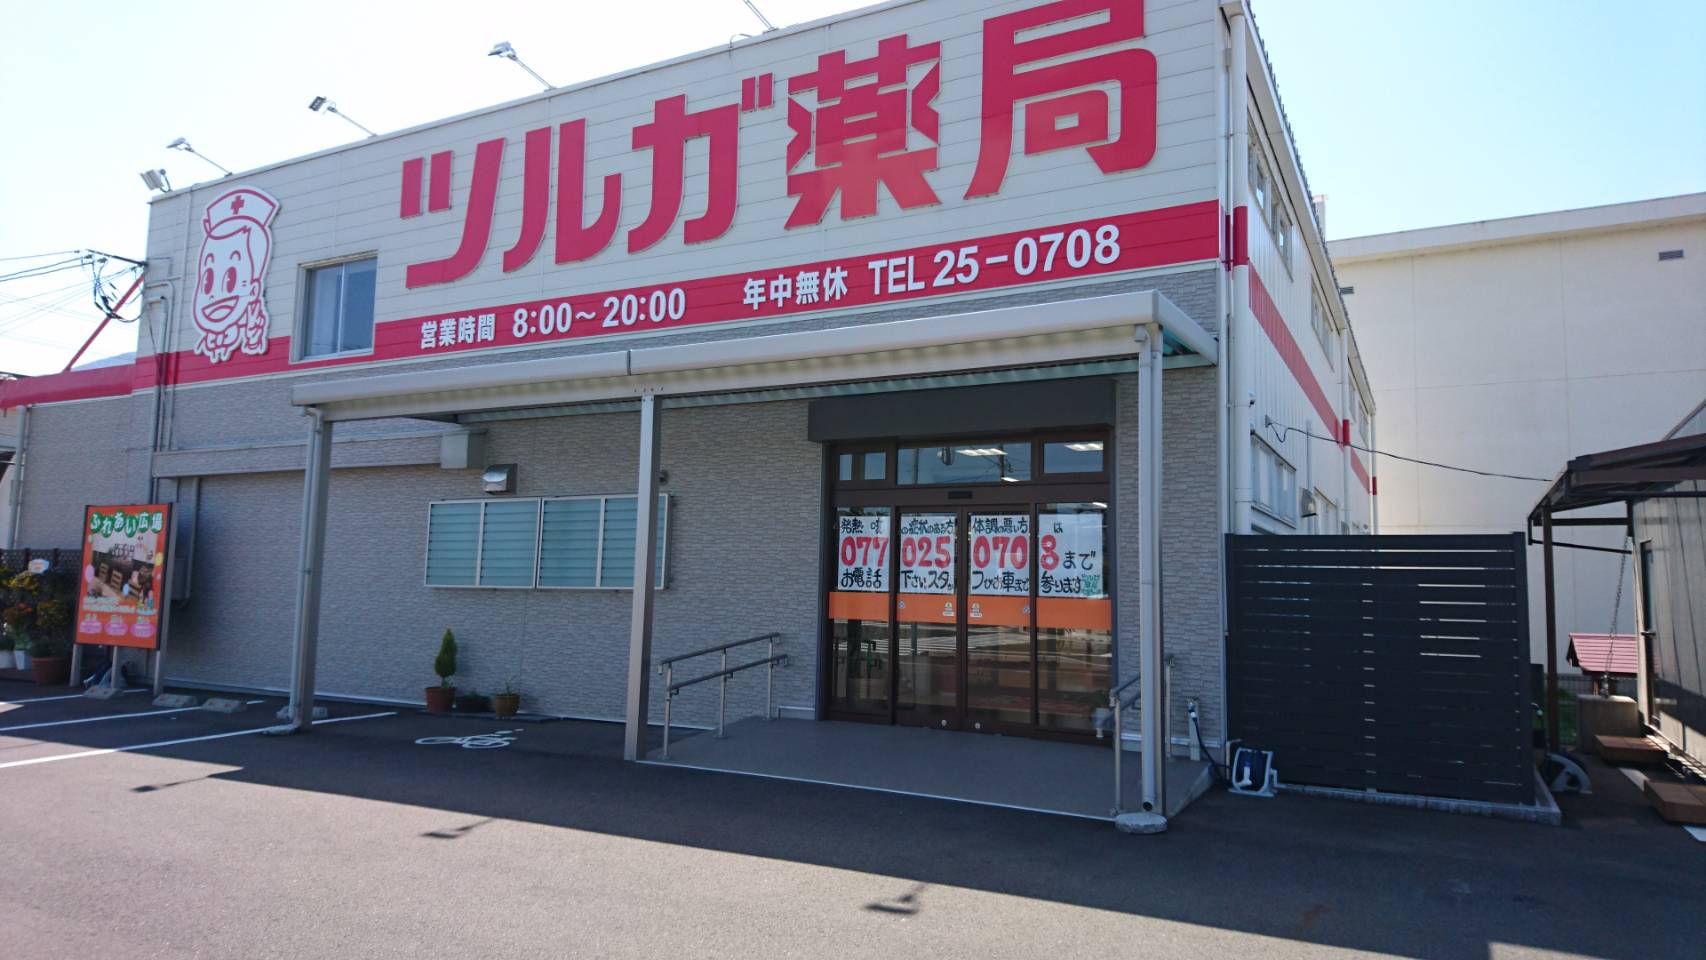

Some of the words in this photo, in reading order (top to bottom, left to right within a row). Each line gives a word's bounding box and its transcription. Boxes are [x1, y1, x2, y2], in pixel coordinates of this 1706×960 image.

[400, 0, 1158, 289] ツルガ薬局
[420, 313, 496, 350] 営業時間
[743, 265, 849, 310] 年中無休
[867, 254, 925, 295] TEL
[90, 511, 164, 537] ふれあい広場
[841, 536, 889, 567] 077
[902, 536, 952, 569] 025
[973, 535, 1029, 570] 070
[1039, 534, 1060, 571] 8
[1062, 549, 1097, 571] まで
[841, 567, 883, 589] お電話
